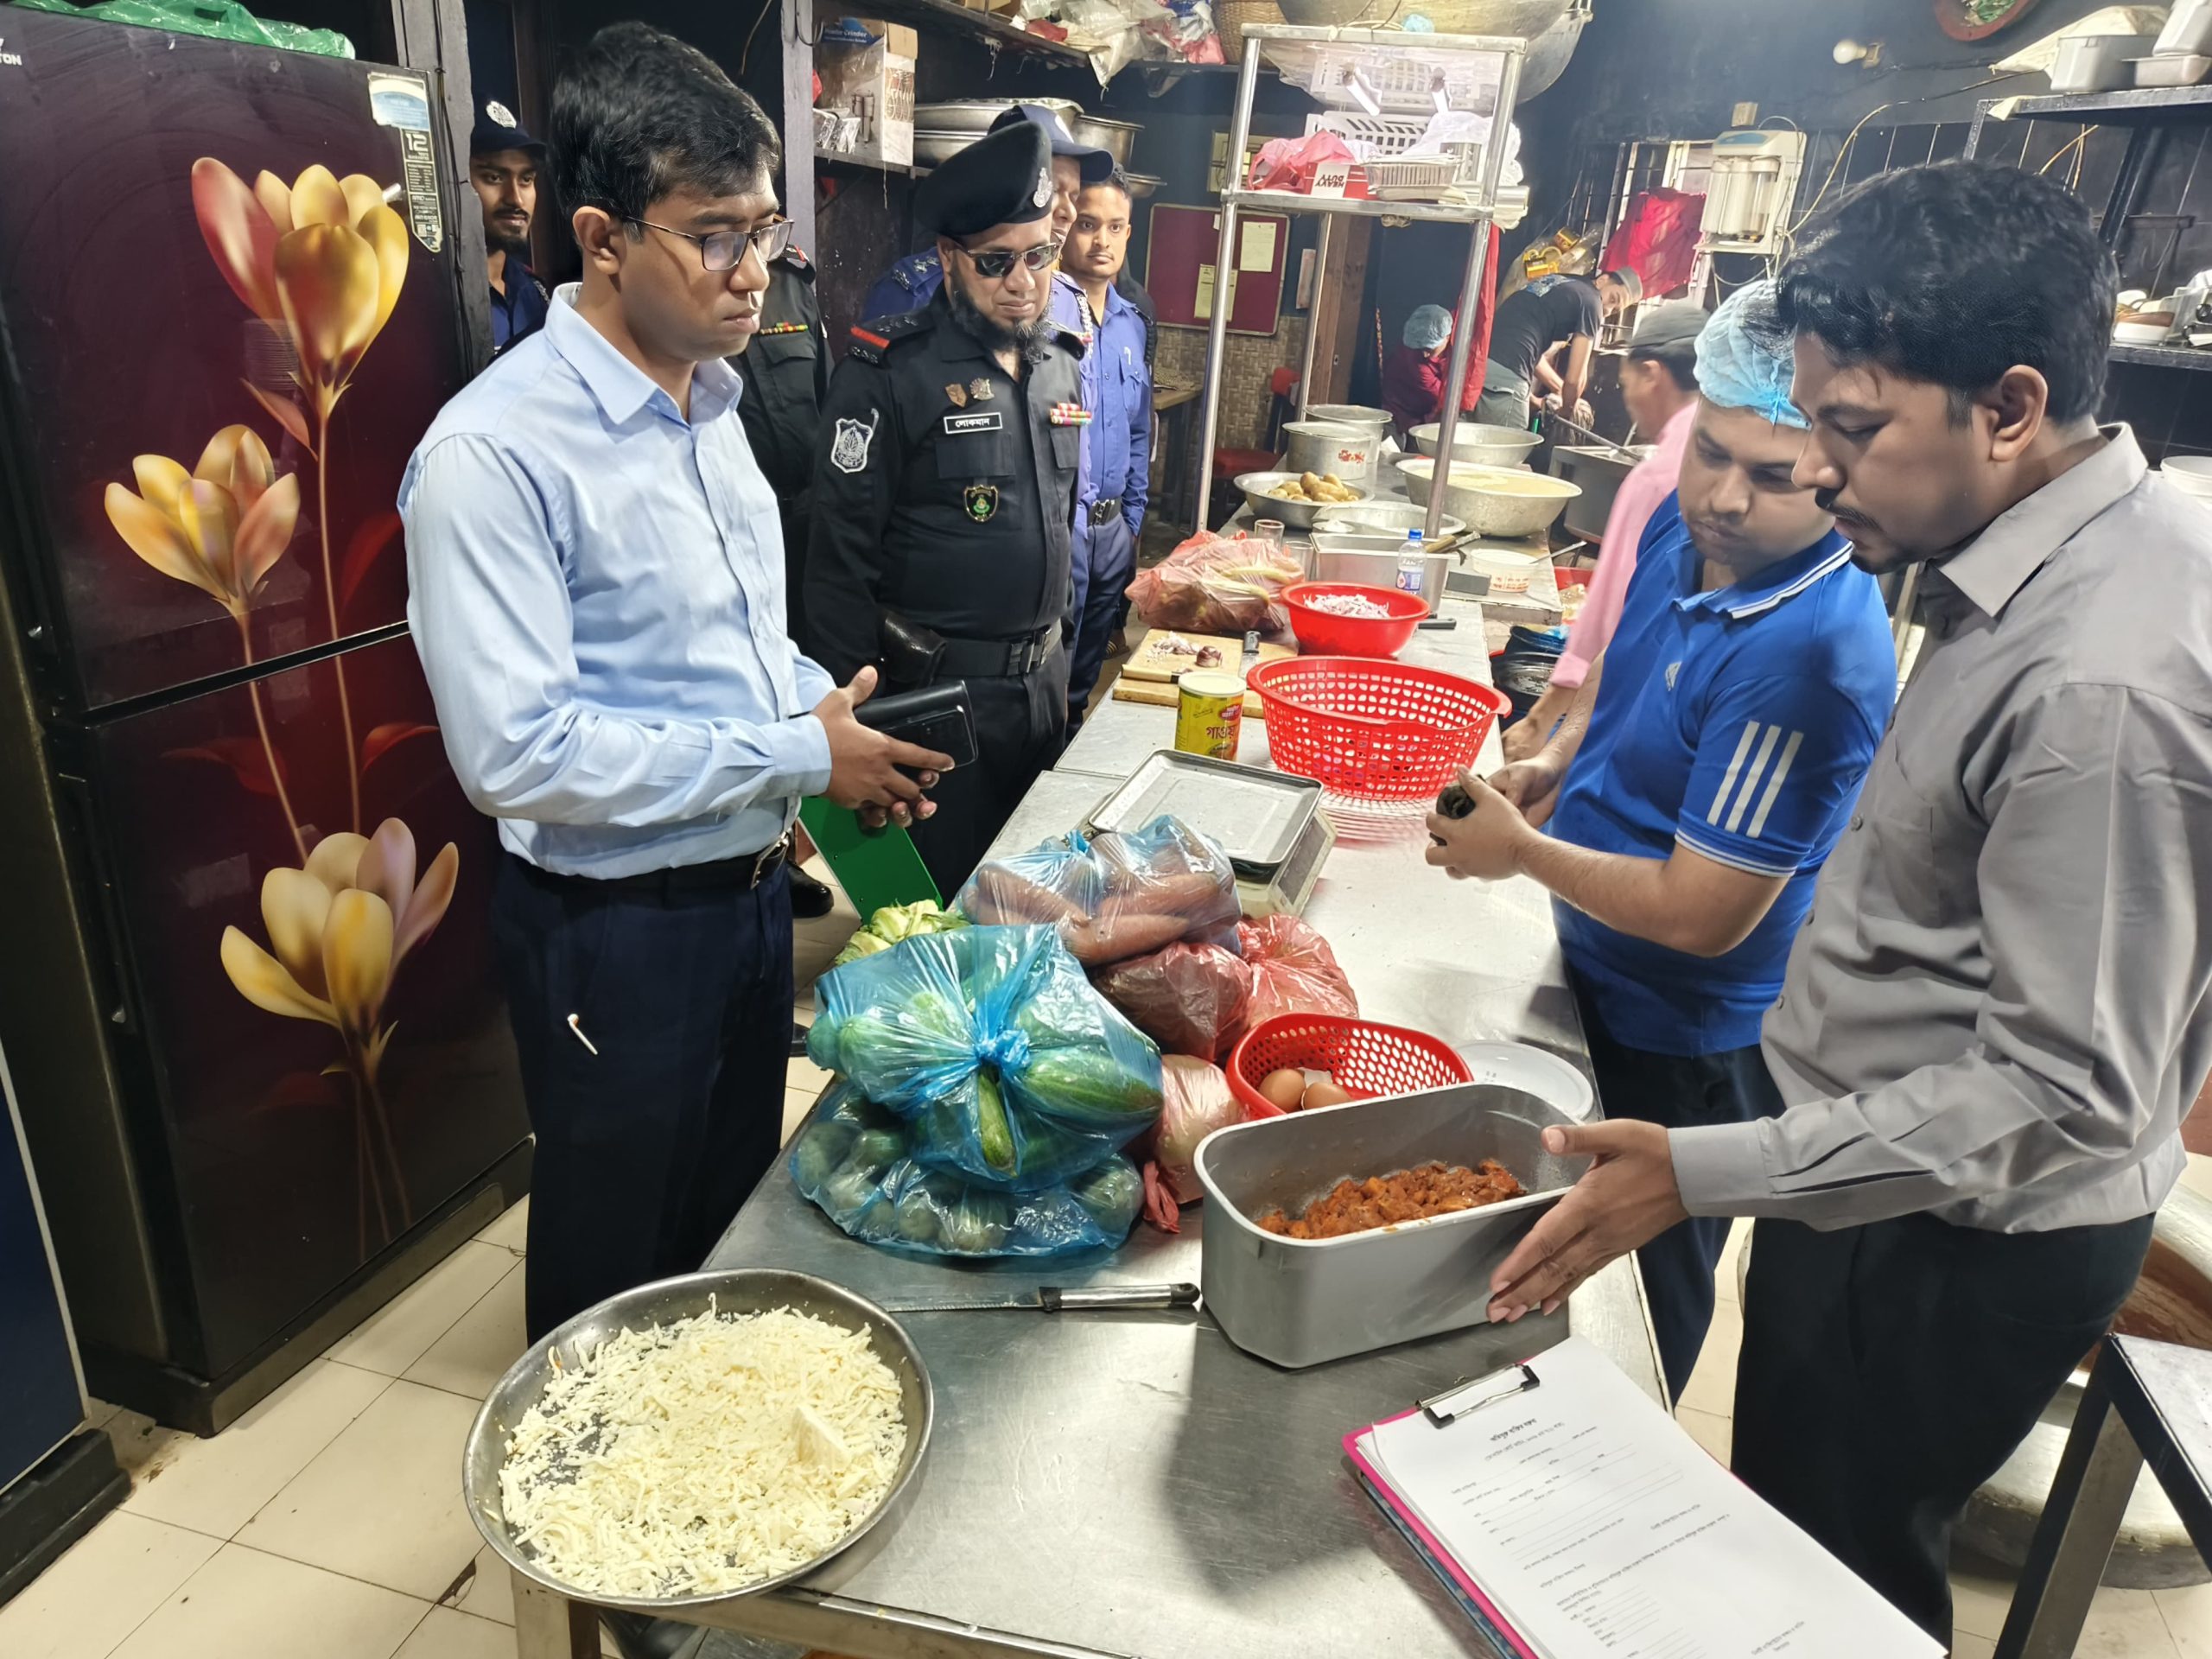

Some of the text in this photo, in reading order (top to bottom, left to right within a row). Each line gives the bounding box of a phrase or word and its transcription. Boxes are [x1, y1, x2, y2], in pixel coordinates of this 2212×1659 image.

[405, 133, 429, 152] 12
[1321, 174, 1344, 182] DUTY
[1314, 179, 1345, 188] HEAVY
